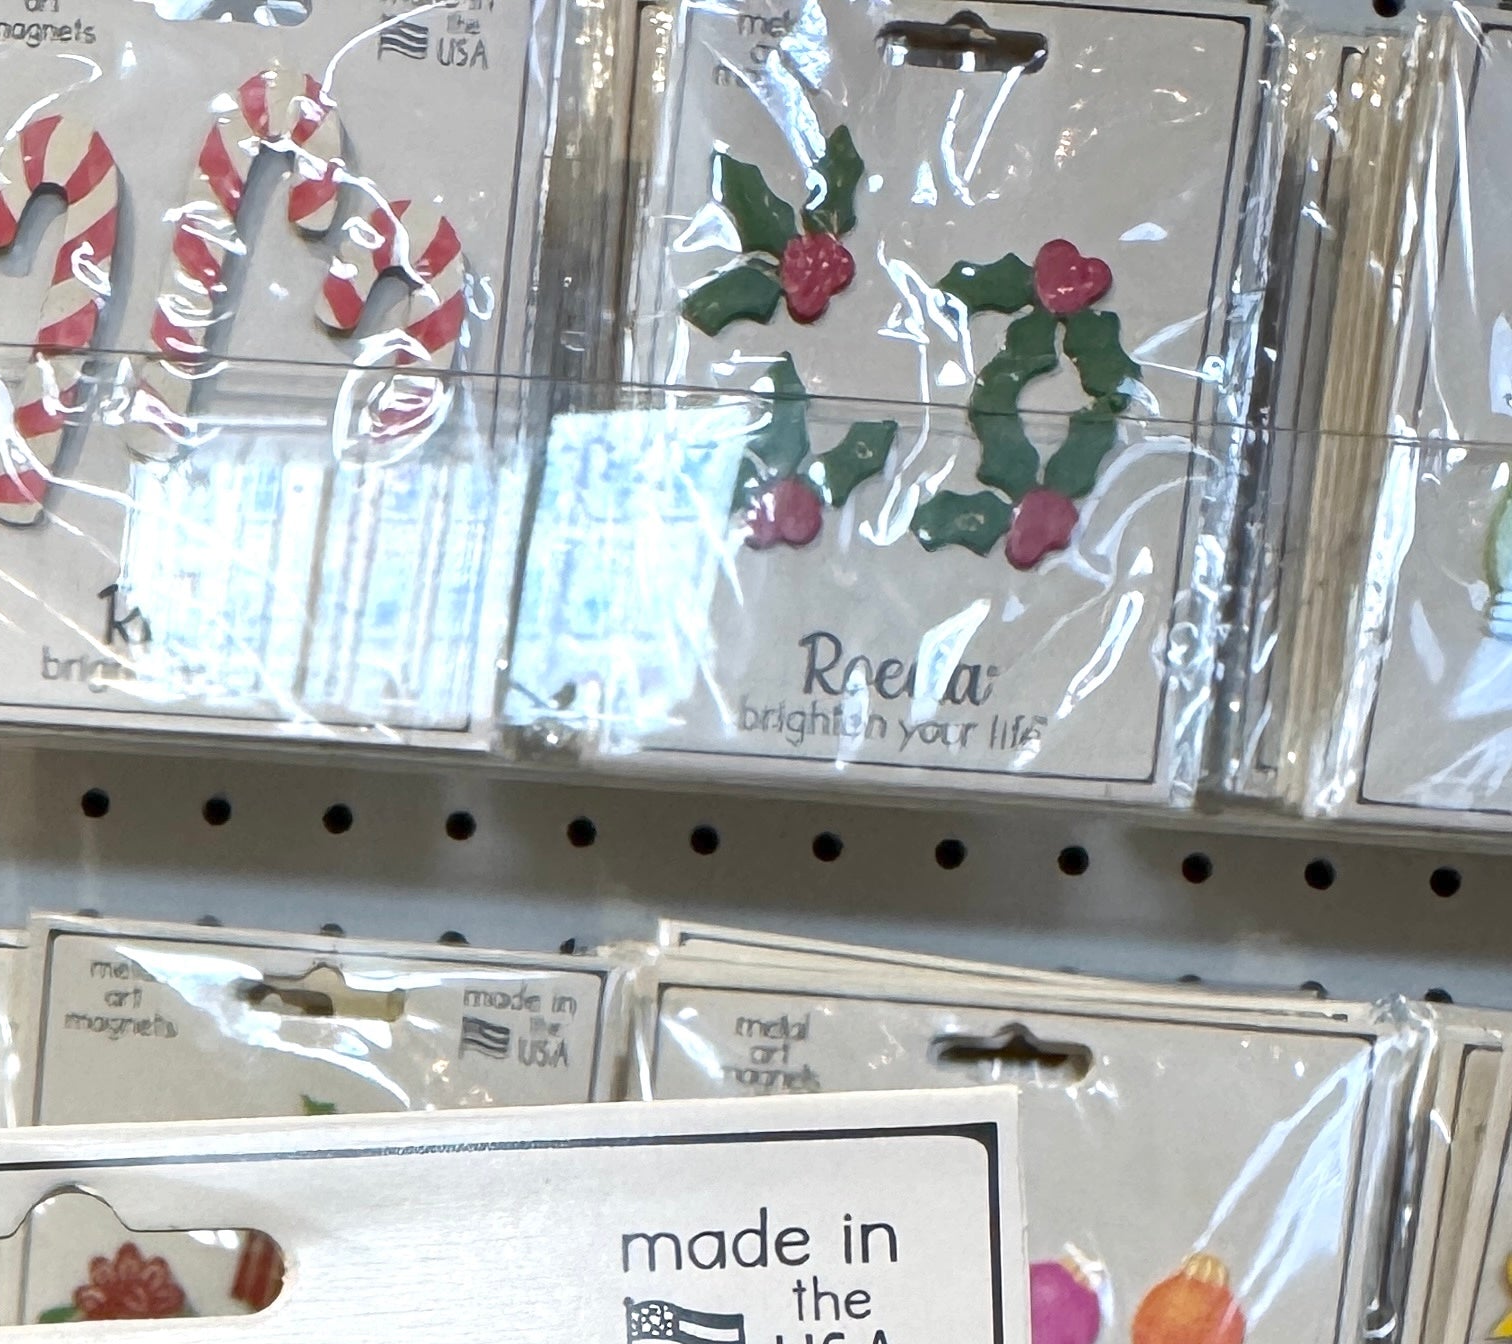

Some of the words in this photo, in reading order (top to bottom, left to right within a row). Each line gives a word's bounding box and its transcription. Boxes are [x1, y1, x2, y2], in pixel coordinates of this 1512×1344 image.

[437, 37, 488, 70] USA
[898, 717, 979, 751] your
[622, 1206, 810, 1273] made
[842, 1212, 898, 1265] in
[791, 1275, 872, 1322] the
